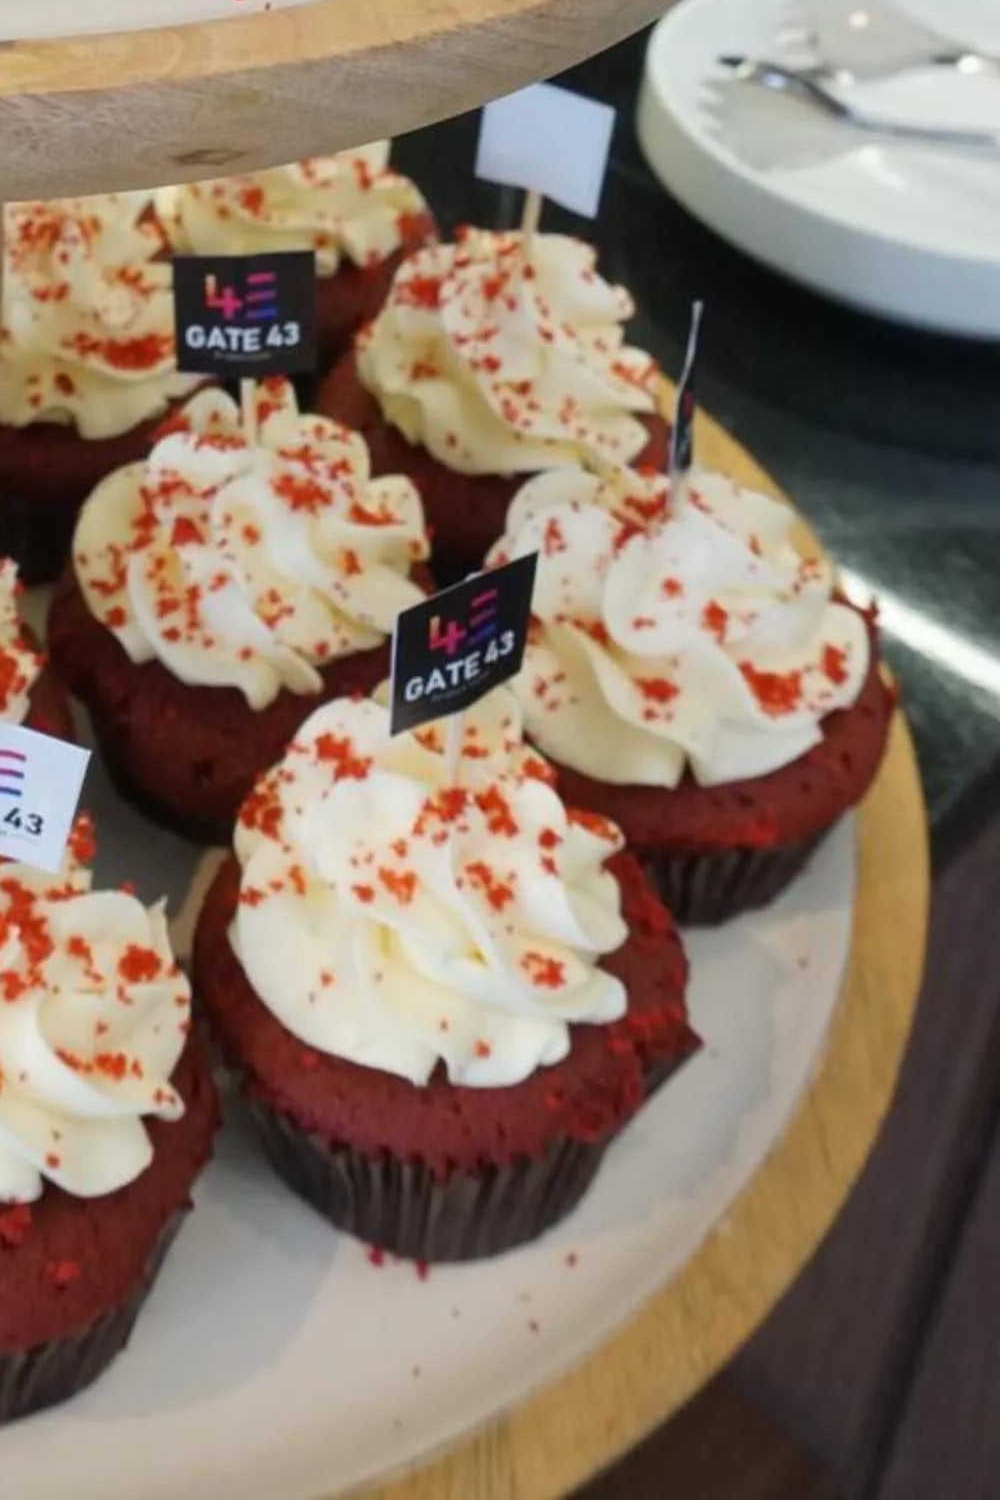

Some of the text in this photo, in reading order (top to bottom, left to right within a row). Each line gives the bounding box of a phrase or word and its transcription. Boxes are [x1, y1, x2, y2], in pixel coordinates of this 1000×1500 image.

[184, 320, 301, 353] GATE 43
[404, 650, 481, 703] GATE
[484, 629, 516, 664] 43
[2, 806, 45, 837] 43
